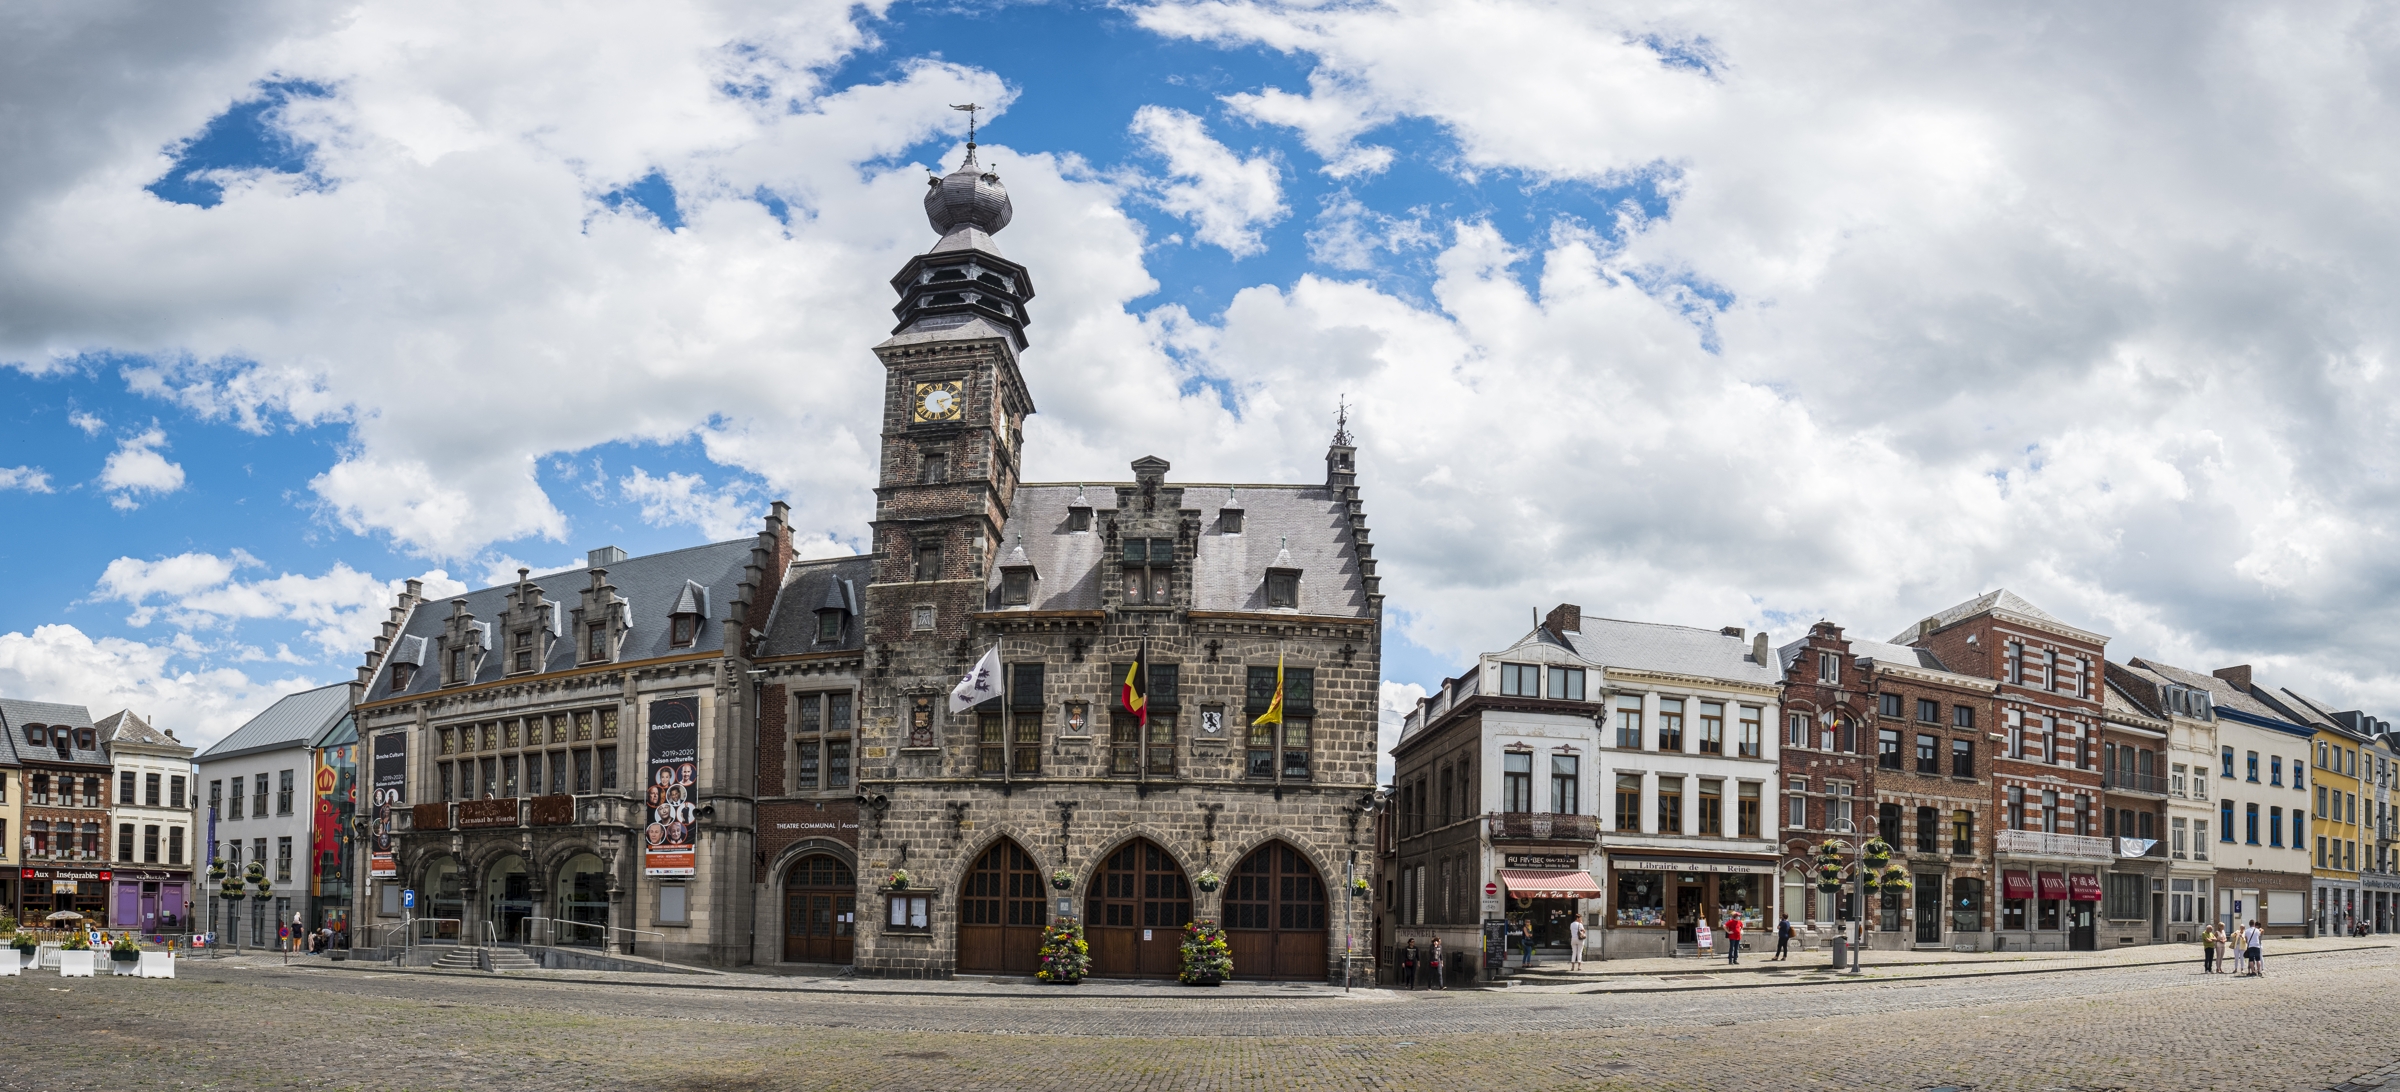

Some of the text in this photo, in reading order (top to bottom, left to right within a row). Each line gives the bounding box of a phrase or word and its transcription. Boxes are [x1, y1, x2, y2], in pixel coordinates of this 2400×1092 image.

[662, 749, 694, 757] 2019>2020
[460, 816, 486, 824] Carnaval
[1639, 862, 1679, 871] Librairie
[1709, 864, 1718, 872] la
[1727, 865, 1751, 873] Reine
[34, 870, 49, 878] Aux
[56, 871, 98, 880] Inséparables
[2008, 876, 2065, 888] CHINA TOWN
[405, 893, 412, 905] P
[1534, 890, 1580, 898] Au Fin Bec
